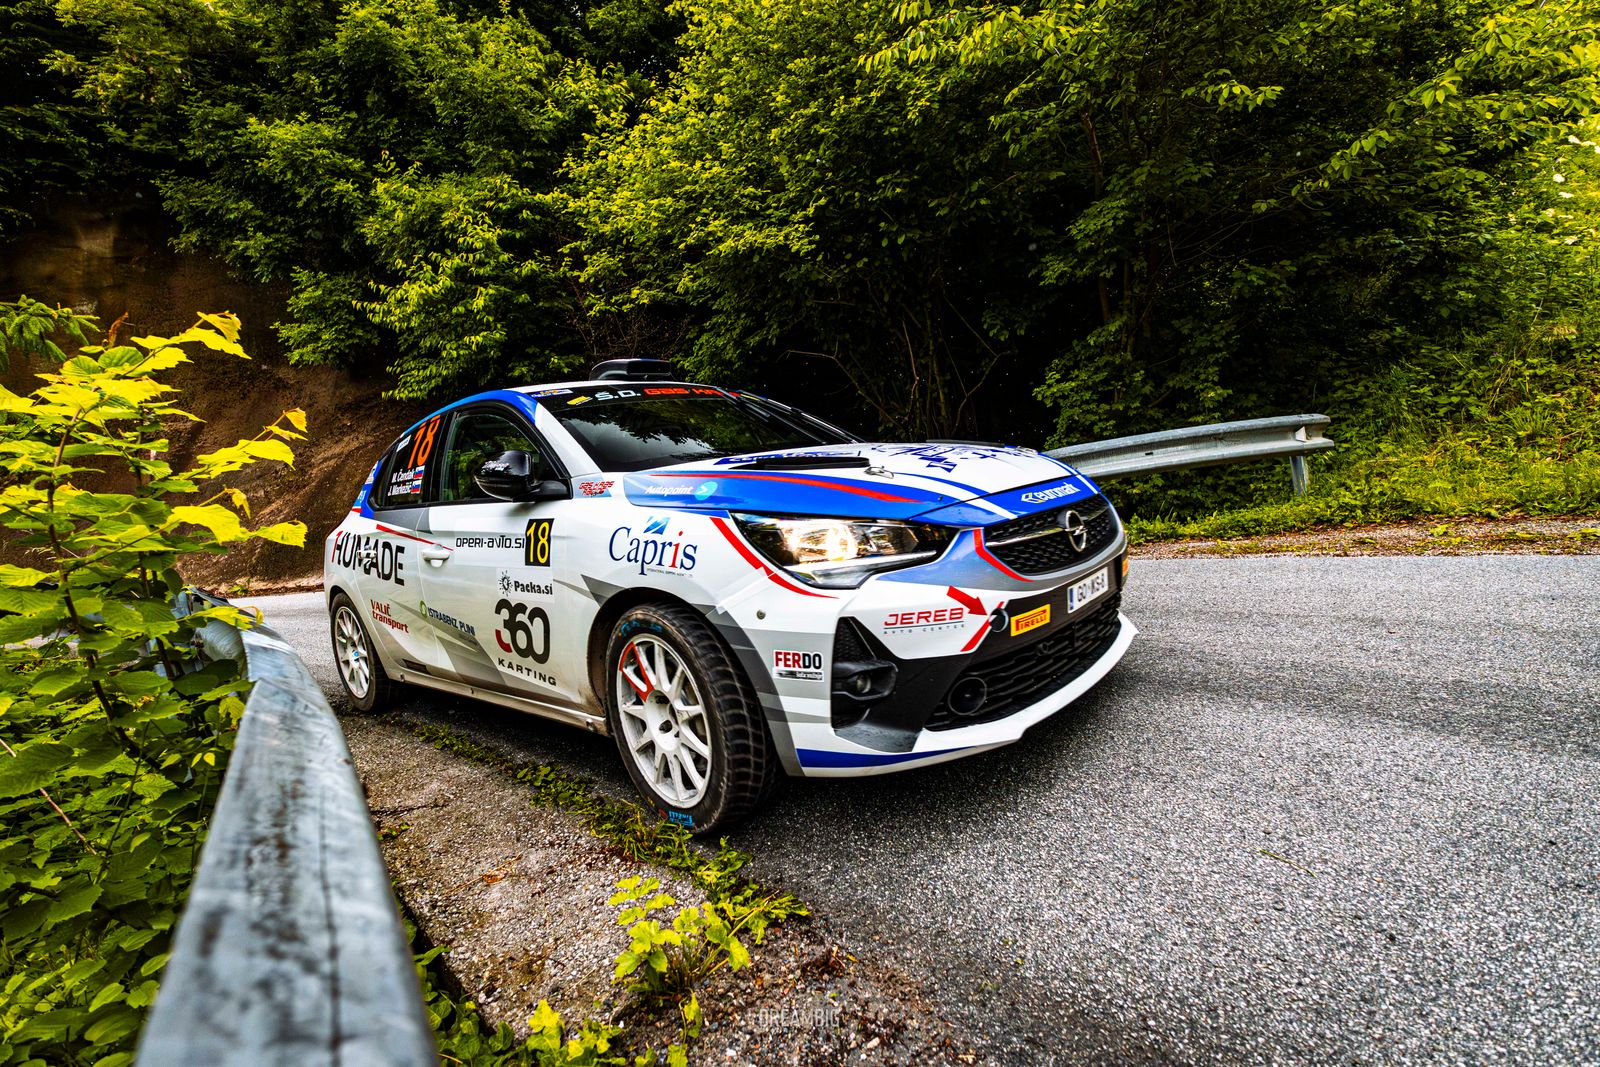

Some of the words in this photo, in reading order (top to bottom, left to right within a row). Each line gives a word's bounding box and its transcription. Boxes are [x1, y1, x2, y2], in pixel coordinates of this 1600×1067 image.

[407, 415, 441, 469] 18
[645, 485, 694, 497] Autopoint
[526, 521, 550, 563] 18
[608, 526, 698, 576] Capris
[513, 580, 553, 595] Packa.si
[370, 599, 391, 617] VALIČ
[884, 607, 964, 626] JEREB
[372, 610, 409, 633] transport
[1015, 609, 1047, 631] PIRELLI
[494, 598, 550, 665] 360
[498, 657, 557, 686] KARTING
[774, 651, 822, 670] FERDO
